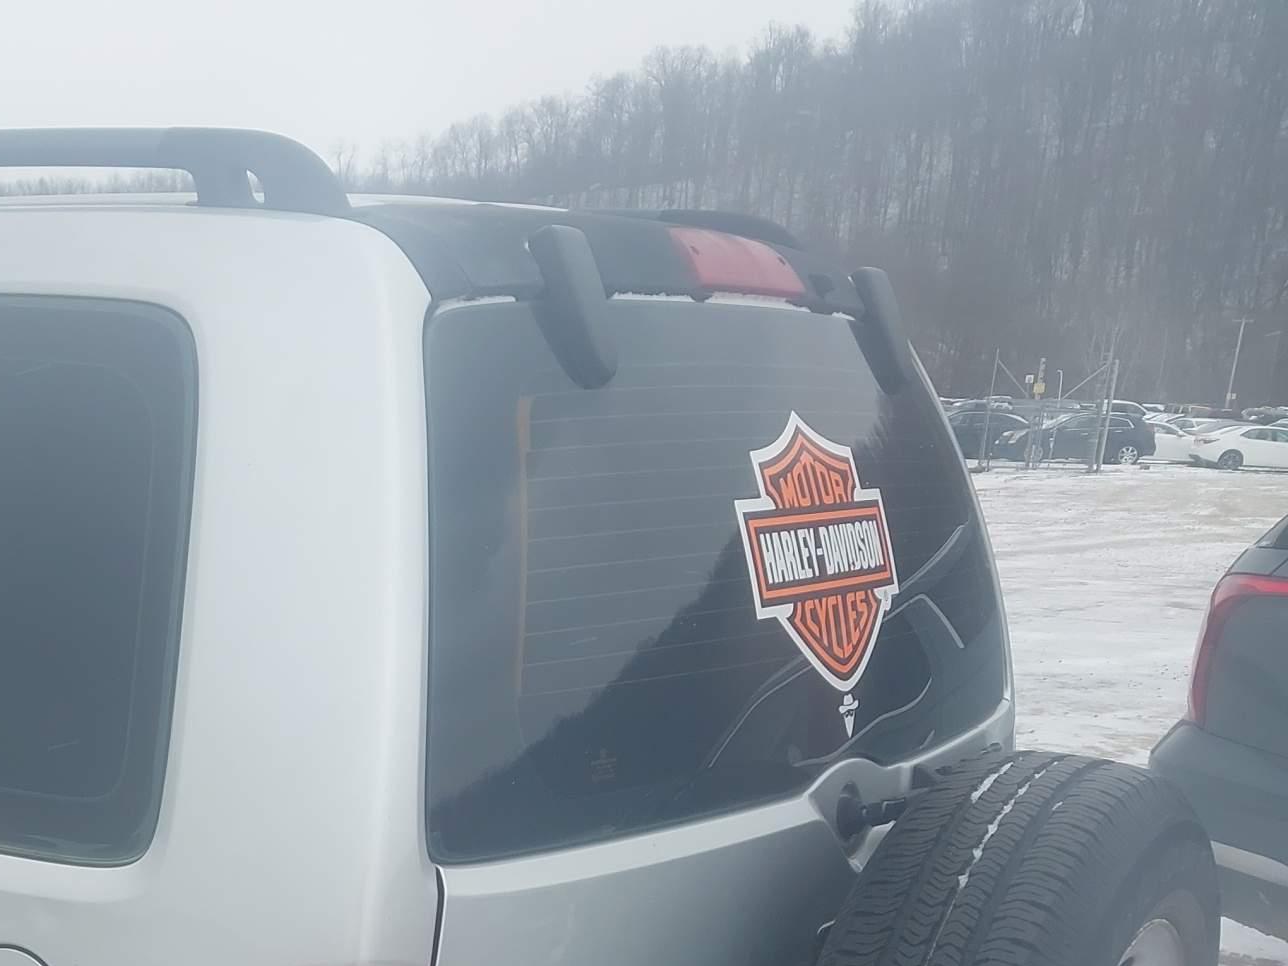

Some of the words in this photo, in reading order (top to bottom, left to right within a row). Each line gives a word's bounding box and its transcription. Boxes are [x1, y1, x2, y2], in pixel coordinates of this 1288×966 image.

[778, 454, 846, 507] MOTOR
[759, 519, 885, 585] HARLEY-DAVIDSON
[804, 591, 868, 659] CYCLES
